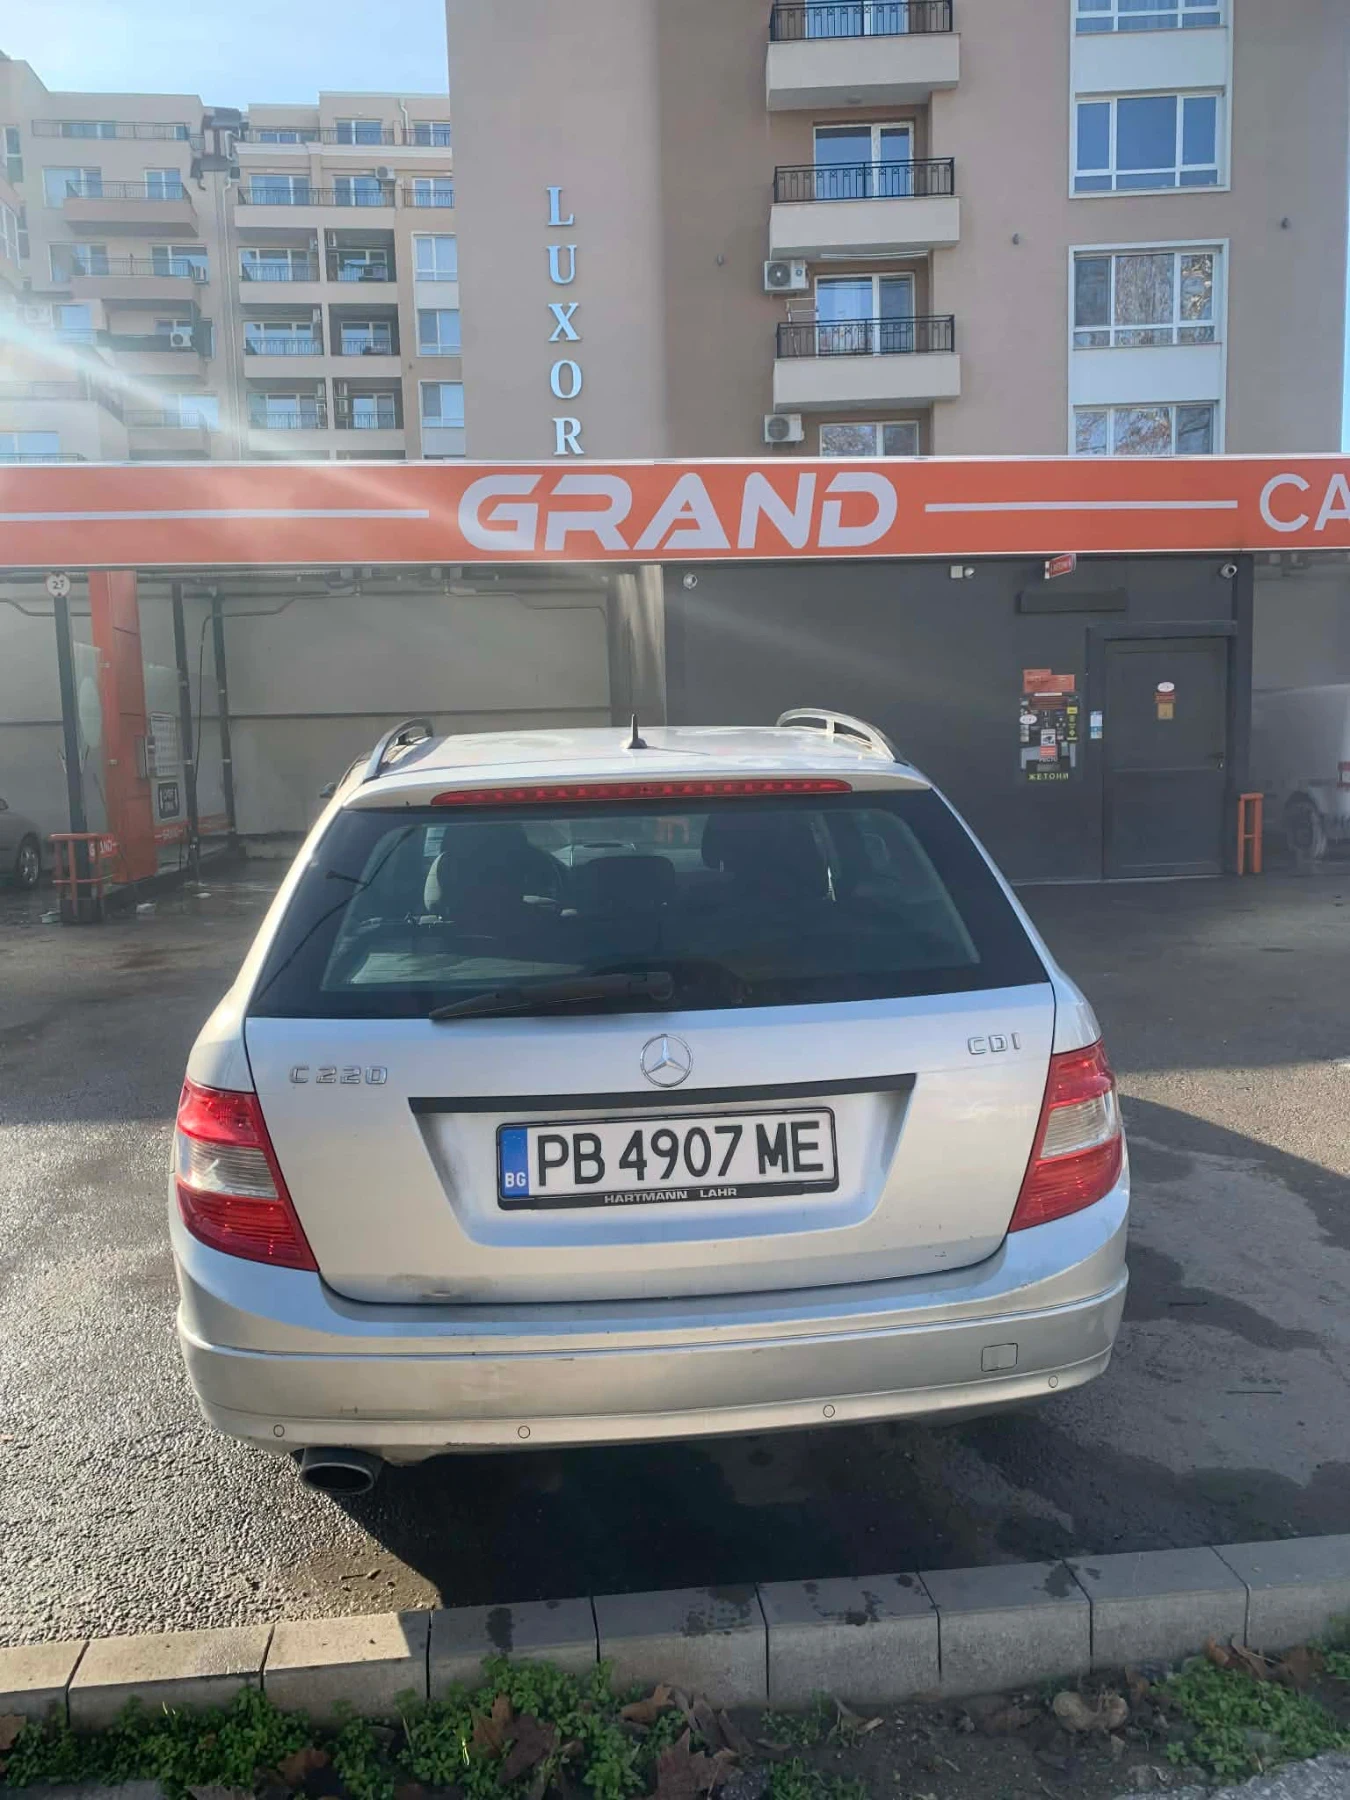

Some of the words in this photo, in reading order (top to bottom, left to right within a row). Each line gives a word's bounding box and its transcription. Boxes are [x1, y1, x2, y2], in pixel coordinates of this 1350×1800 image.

[546, 186, 584, 456] LUXOR
[458, 472, 898, 551] GRAND
[967, 1032, 1021, 1055] CDI
[619, 1125, 743, 1180] 4907
[756, 1121, 824, 1175] ME
[505, 1172, 527, 1188] BG
[604, 1190, 688, 1204] HARTMANN
[700, 1187, 737, 1198] LAHR
